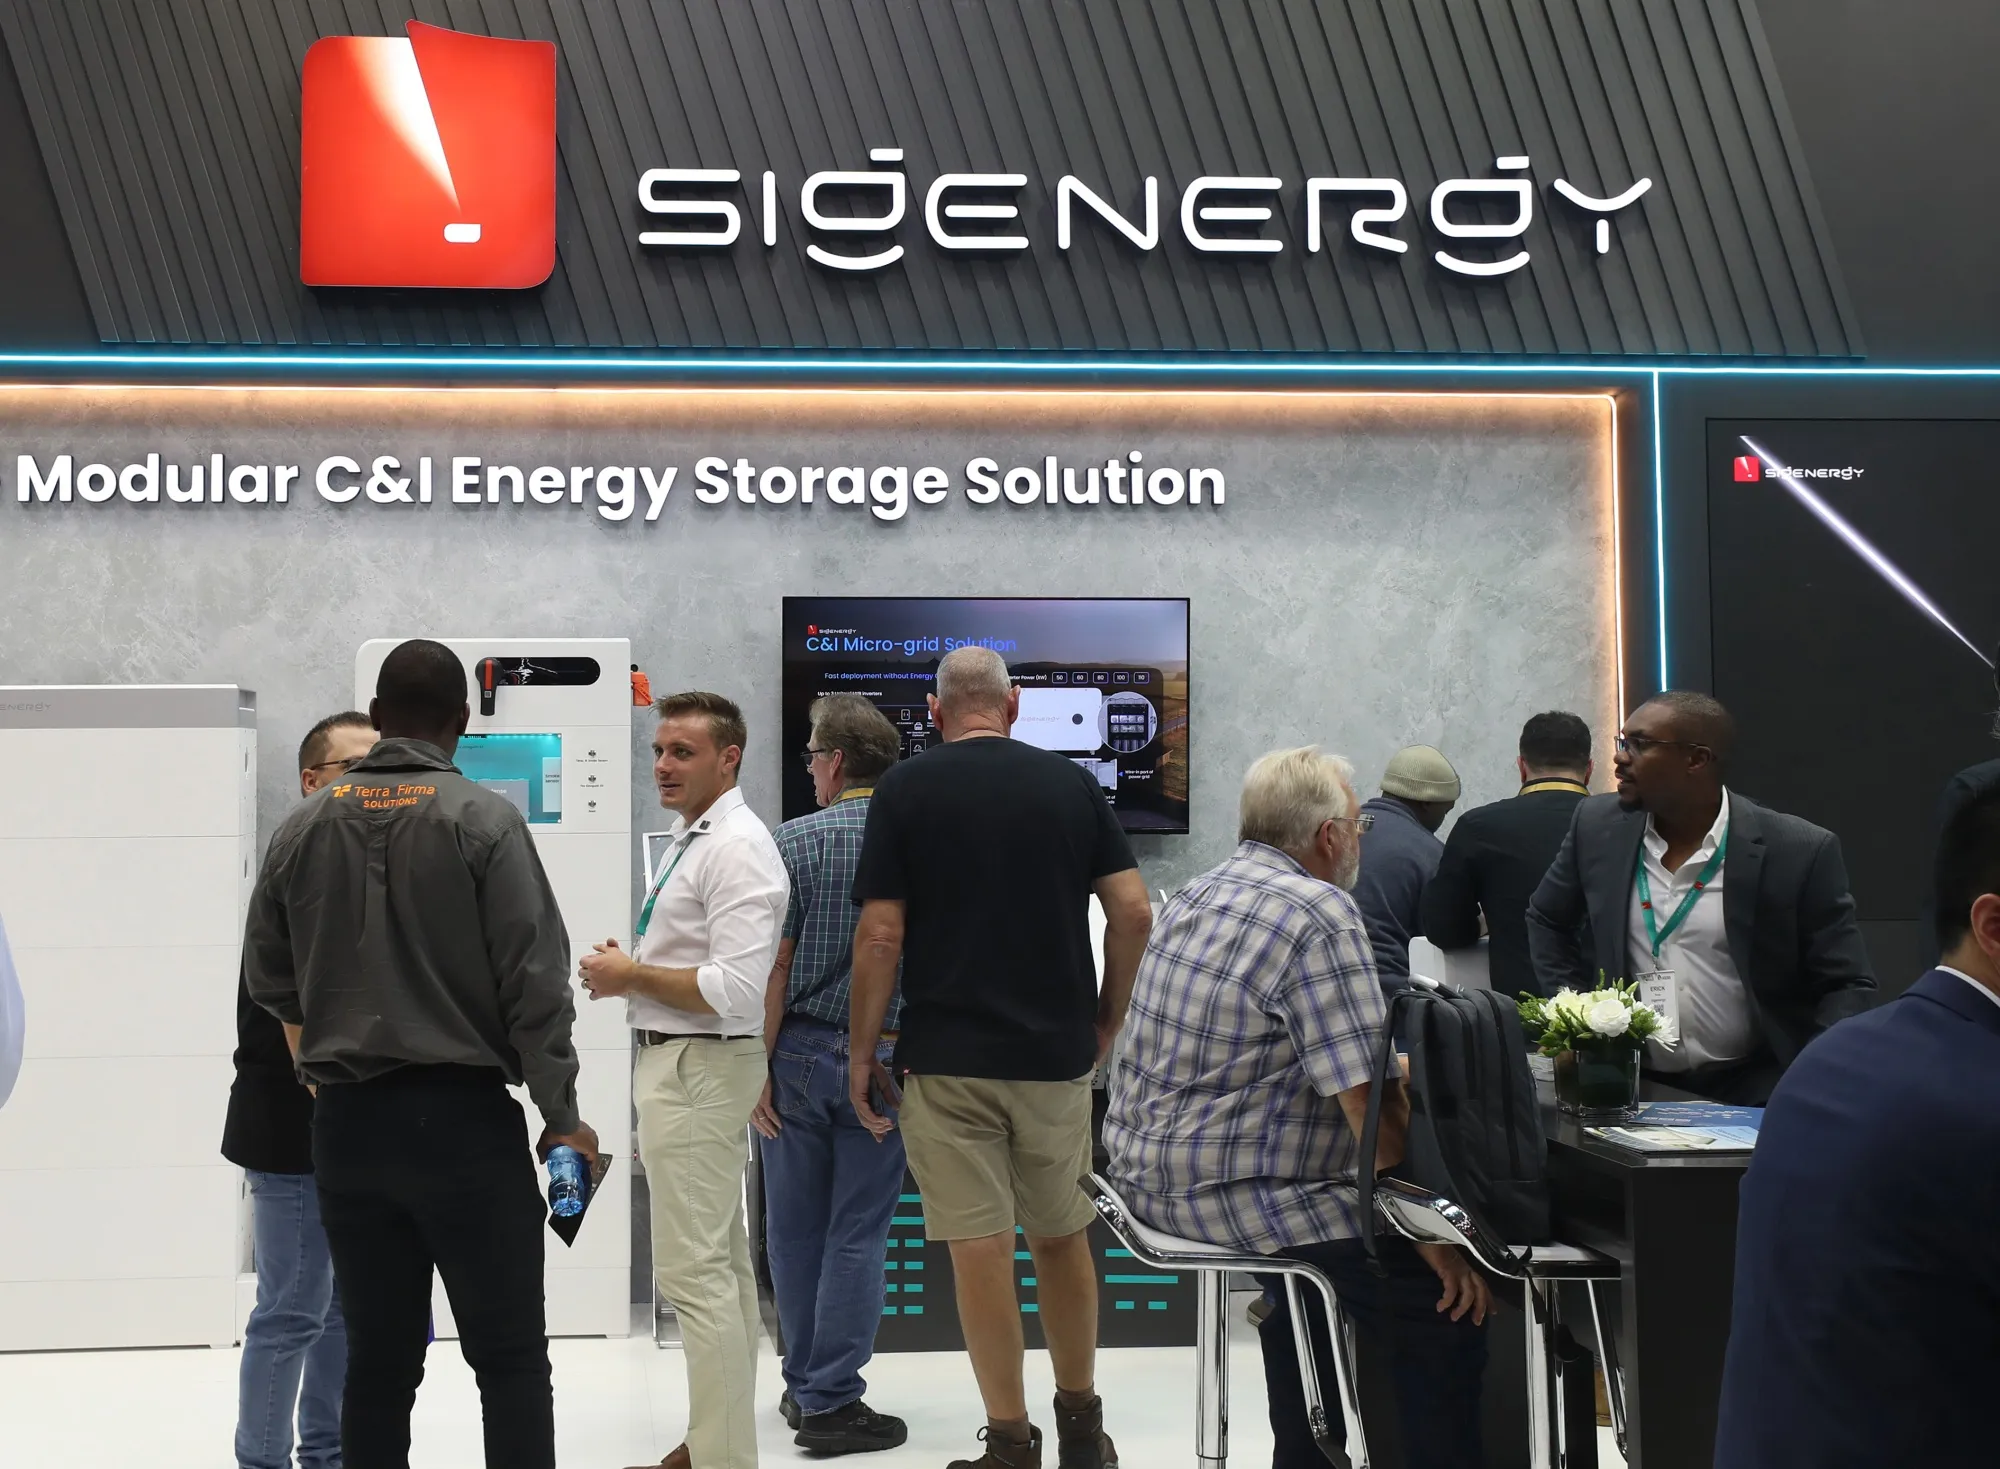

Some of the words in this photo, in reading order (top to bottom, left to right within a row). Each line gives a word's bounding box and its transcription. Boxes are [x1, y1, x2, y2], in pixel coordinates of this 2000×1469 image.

[638, 148, 1652, 276] SIGENERGY
[17, 453, 299, 503] Modular
[315, 455, 433, 504] C&I
[452, 456, 678, 521] Energy
[694, 456, 949, 520] Storage
[965, 450, 1226, 505] Solution
[806, 637, 838, 652] C&I
[844, 636, 939, 656] Micro-grid
[824, 672, 839, 680] Fast
[840, 672, 882, 681] deployment
[883, 672, 909, 680] without
[910, 673, 933, 681] Energy
[354, 786, 391, 797] Terra
[397, 784, 435, 796] Firma
[363, 797, 418, 808] SOLUTIONS
